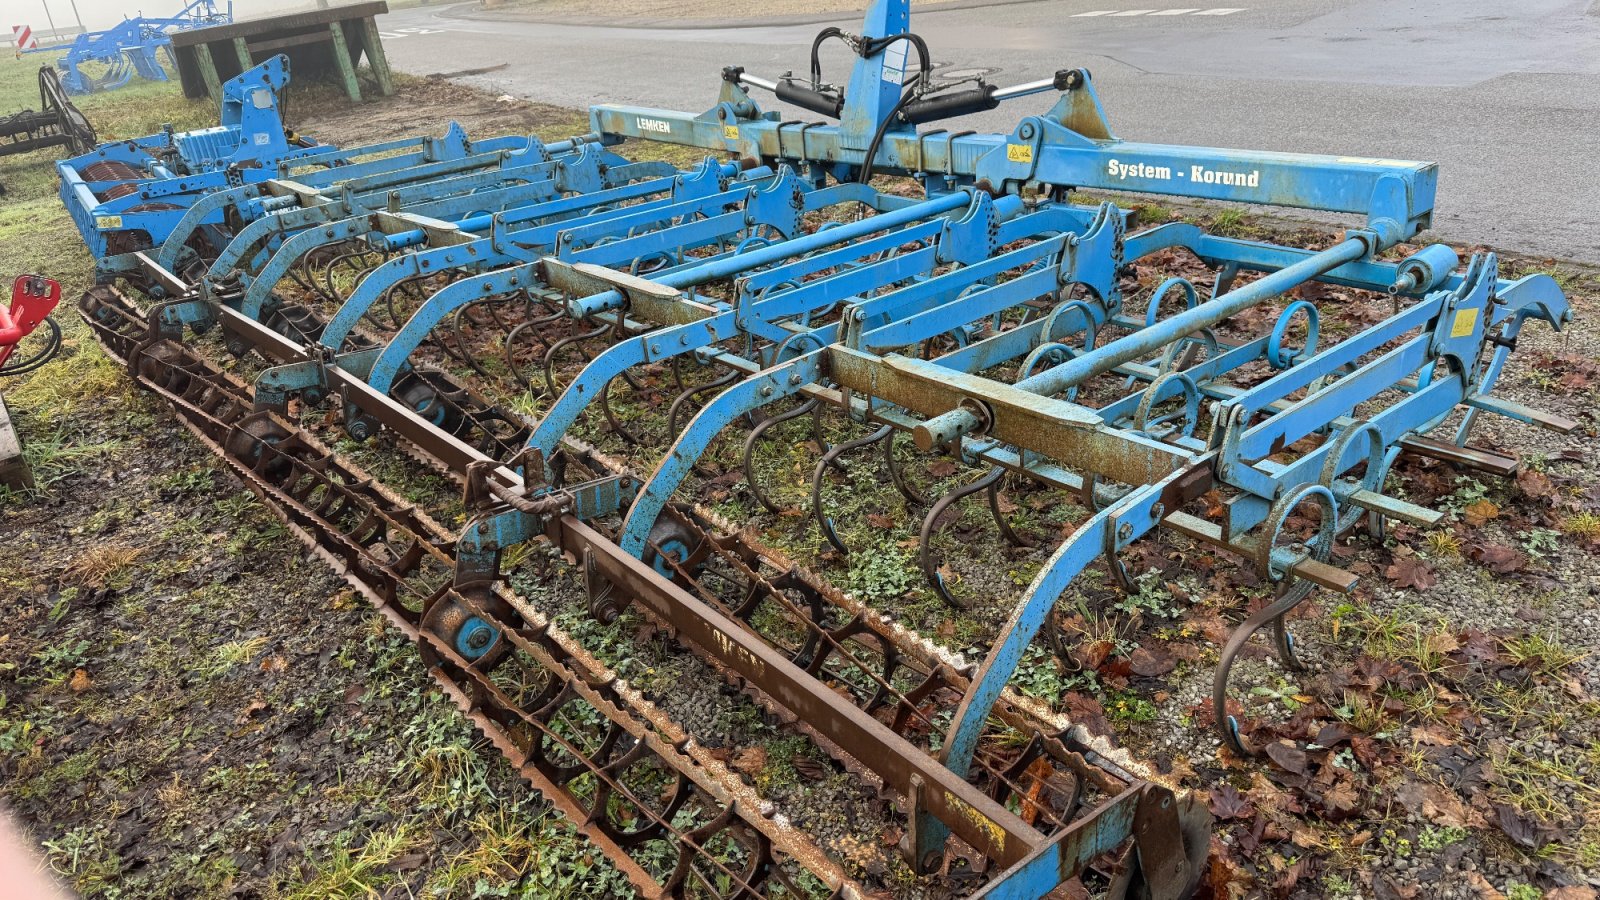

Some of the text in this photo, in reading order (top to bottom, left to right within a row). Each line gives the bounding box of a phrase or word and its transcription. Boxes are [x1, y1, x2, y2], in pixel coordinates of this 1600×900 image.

[636, 117, 671, 134] LEMKEN
[1108, 159, 1171, 180] System
[1190, 165, 1260, 188] Korund
